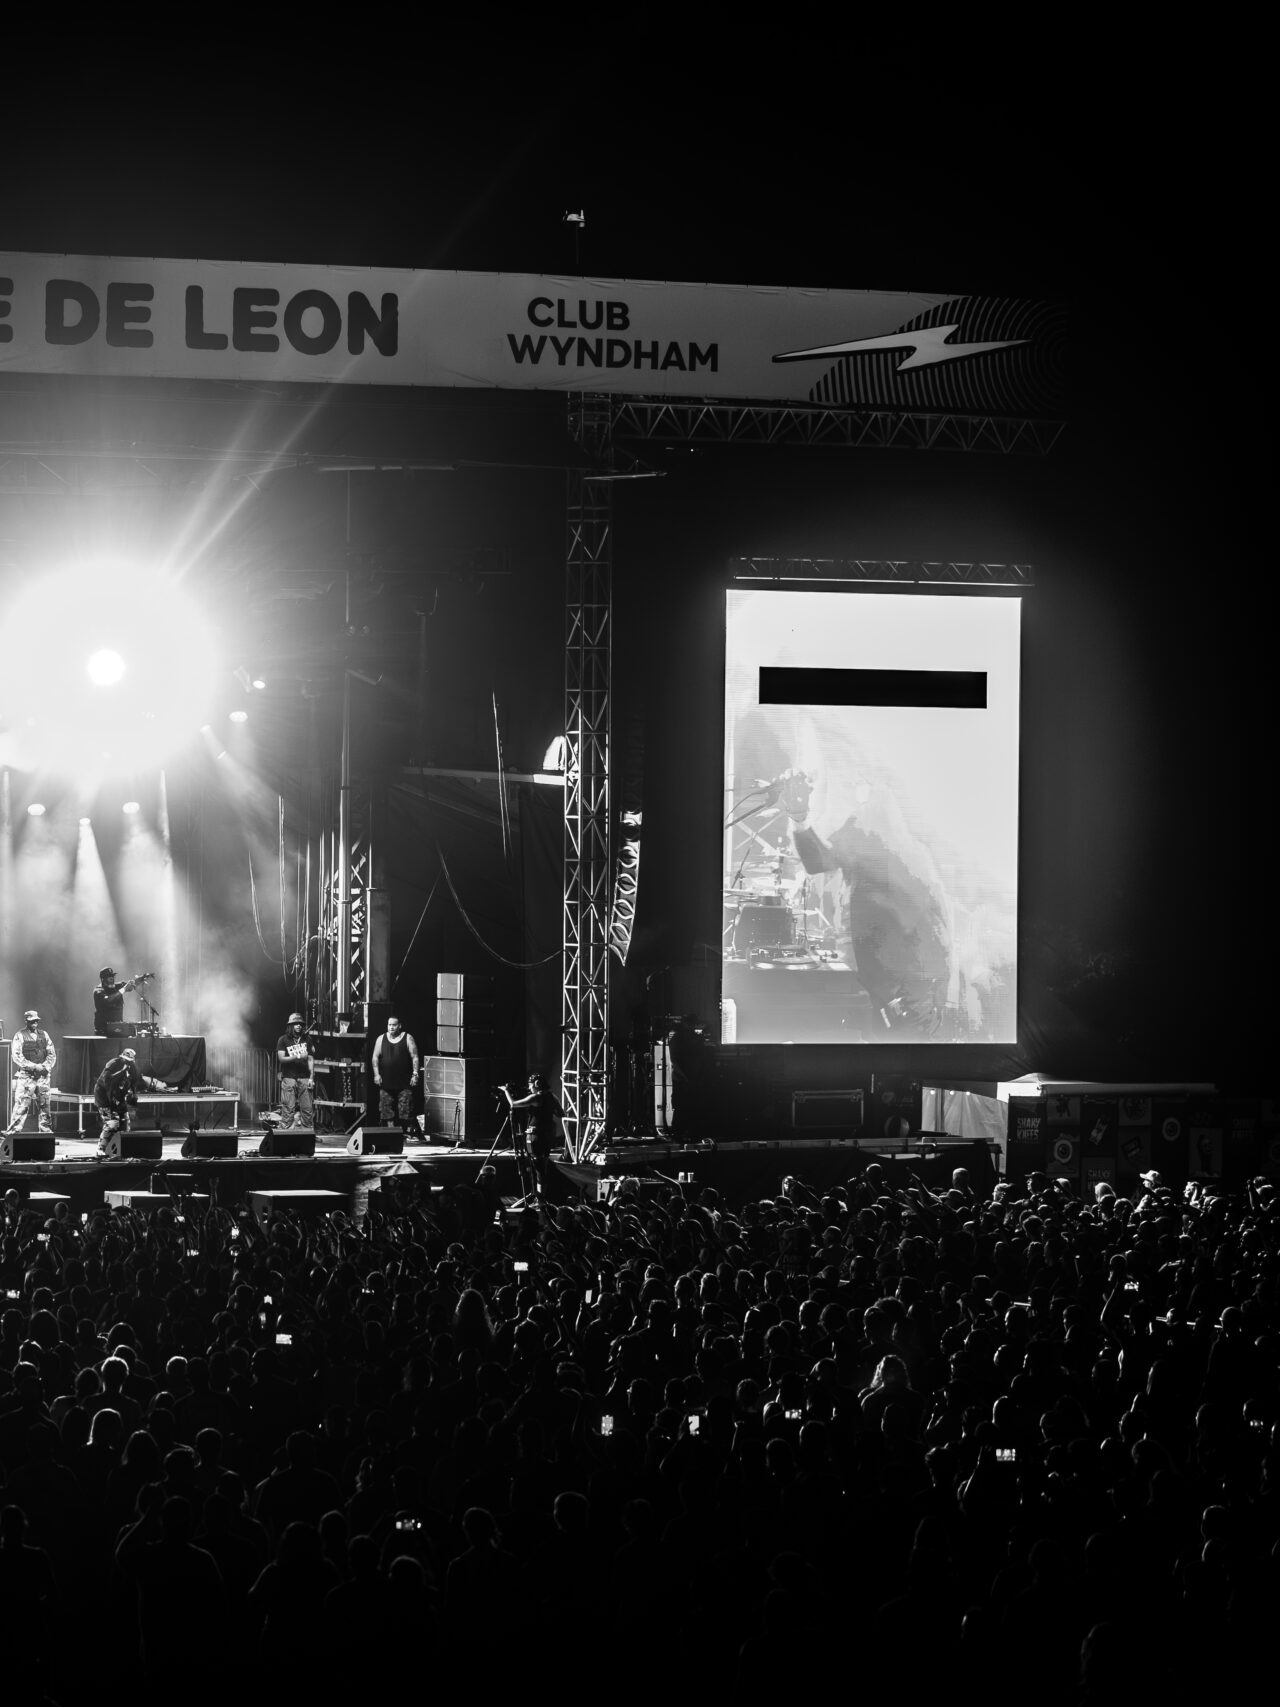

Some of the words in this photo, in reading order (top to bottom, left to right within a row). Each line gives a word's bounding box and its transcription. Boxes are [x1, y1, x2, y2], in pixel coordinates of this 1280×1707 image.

[44, 277, 155, 348] DE
[185, 284, 400, 358] LEON
[527, 296, 631, 332] CLUB
[507, 333, 719, 373] WYNDHAM
